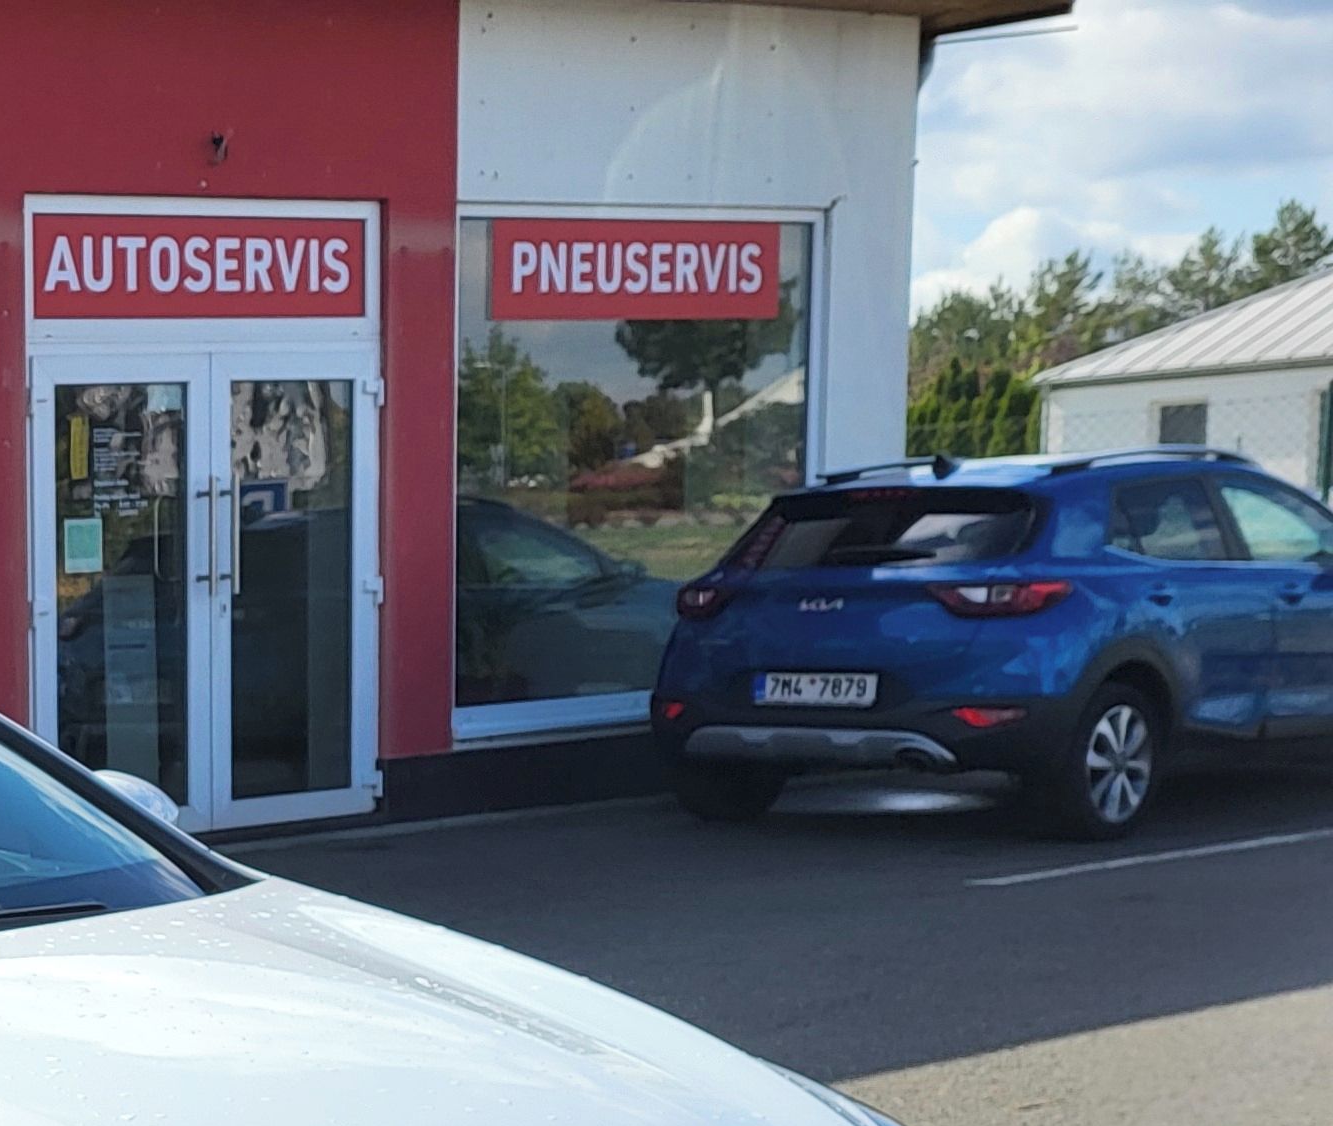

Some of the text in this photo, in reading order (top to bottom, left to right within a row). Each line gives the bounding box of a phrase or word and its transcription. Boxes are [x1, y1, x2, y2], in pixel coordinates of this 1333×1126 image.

[43, 234, 351, 294] AUTOSERVIS
[510, 240, 763, 295] PNEUSERVIS
[770, 677, 803, 697] 7M4
[819, 678, 868, 698] 7879
